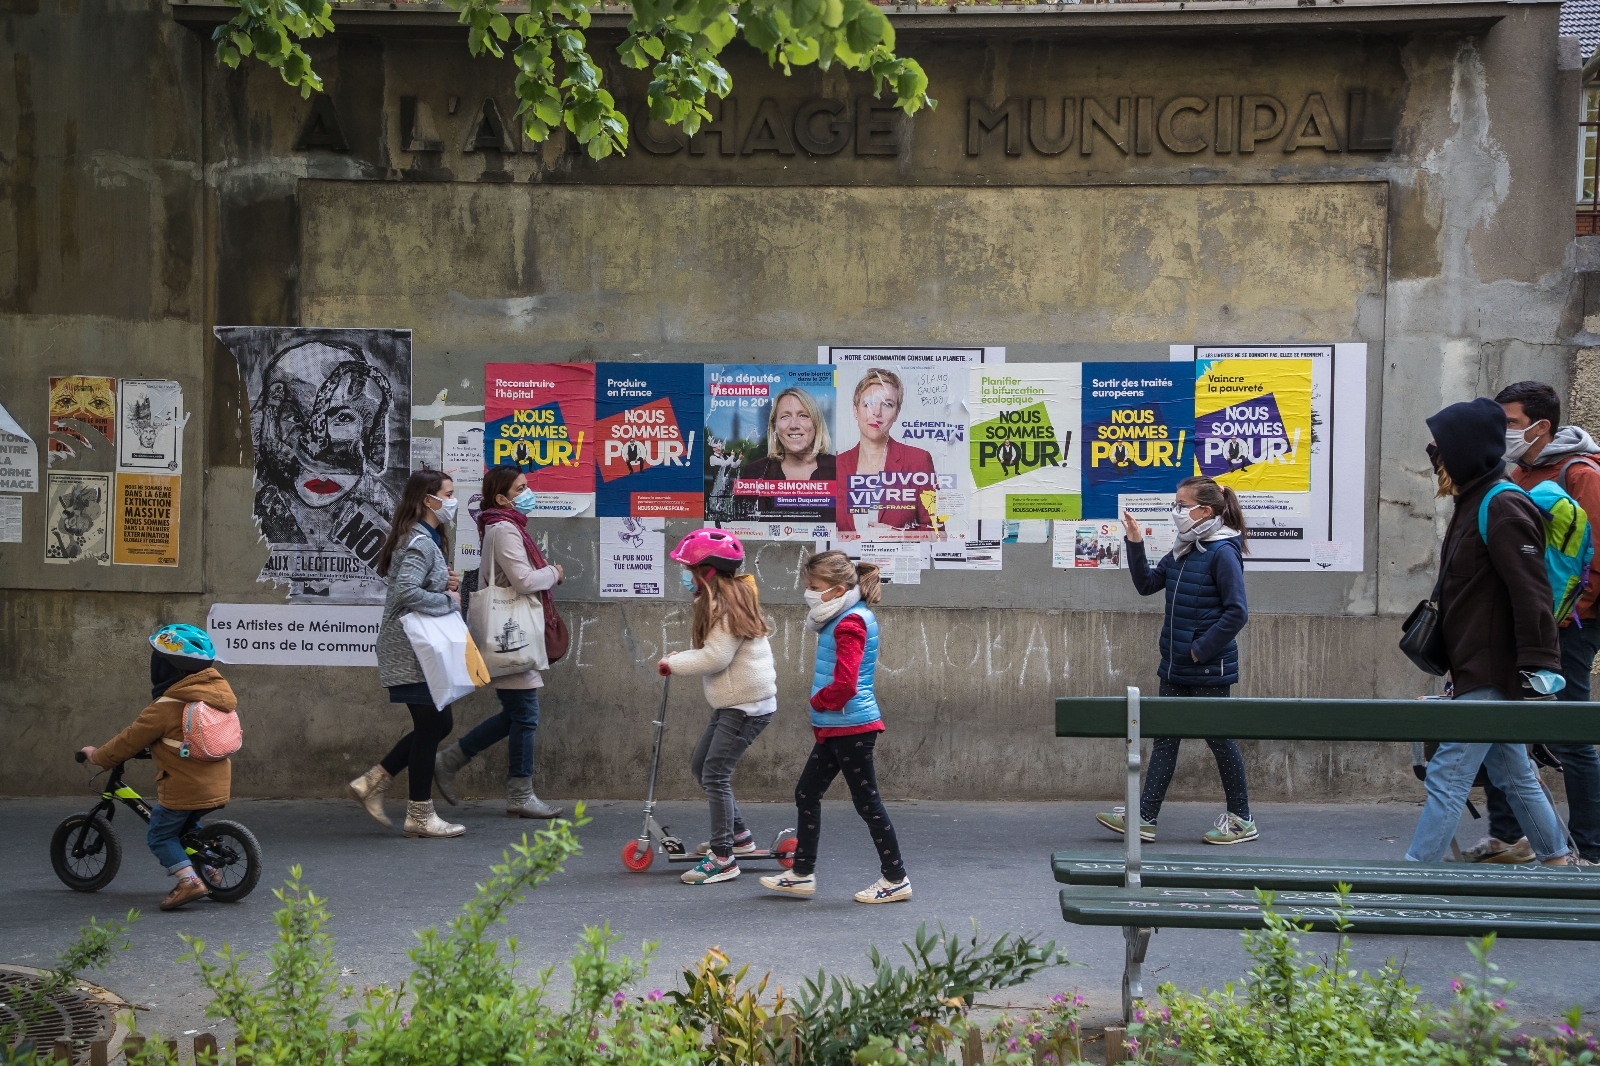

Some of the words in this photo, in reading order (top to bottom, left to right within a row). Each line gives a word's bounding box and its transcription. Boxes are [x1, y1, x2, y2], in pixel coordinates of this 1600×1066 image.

[400, 95, 898, 158] L'ACHAGE
[966, 86, 1396, 158] MUNICIPAL
[862, 354, 906, 362] CONSOMMATION
[907, 354, 934, 362] CONSUME
[495, 378, 556, 389] Reconstruire
[607, 378, 647, 388] Produire
[710, 372, 734, 384] Une
[736, 372, 781, 385] députée
[981, 376, 1021, 386] Planifier
[1092, 378, 1120, 388] Sortir
[1121, 378, 1138, 388] des
[1141, 378, 1172, 388] traités
[1208, 374, 1244, 383] Vaincre
[495, 388, 534, 400] l'hôpital
[607, 389, 619, 397] en
[620, 388, 652, 397] France
[981, 386, 990, 394] la
[992, 386, 1044, 395] bifurcation
[1092, 388, 1144, 400] européens
[1208, 384, 1218, 393] la
[1219, 383, 1263, 394] pauvreté
[710, 398, 736, 410] pour
[738, 398, 749, 408] le
[981, 395, 1033, 406] écologique
[514, 409, 554, 424] NOUS
[624, 409, 666, 424] NOUS
[999, 410, 1041, 424] NOUS
[1111, 410, 1154, 424] NOUS
[1225, 406, 1269, 420] NOUS
[501, 424, 568, 438] SOMMES
[611, 424, 678, 439] SOMMES
[986, 426, 1054, 440] SOMMES
[1097, 425, 1168, 439] SOMMES
[1211, 422, 1282, 436] SOMMES
[902, 429, 964, 442] AUTAIN
[0, 480, 34, 490] MAGE
[737, 482, 776, 491] Danielle
[778, 482, 828, 491] SIMONNET
[850, 472, 954, 490] POUVOIR
[125, 498, 172, 507] EXTINCTION
[849, 488, 916, 506] VIVRE
[125, 507, 170, 519] MASSIVE
[860, 504, 916, 513] ÎL-DE-FRANCE
[124, 531, 170, 539] EXTERMINATION
[268, 556, 288, 571] AUX
[211, 618, 232, 630] Les
[236, 619, 283, 632] Artistes
[288, 620, 305, 632] de
[309, 620, 381, 634] Ménilmont
[225, 638, 248, 650] 150
[252, 640, 275, 650] ans
[280, 639, 298, 651] de
[301, 640, 314, 651] la
